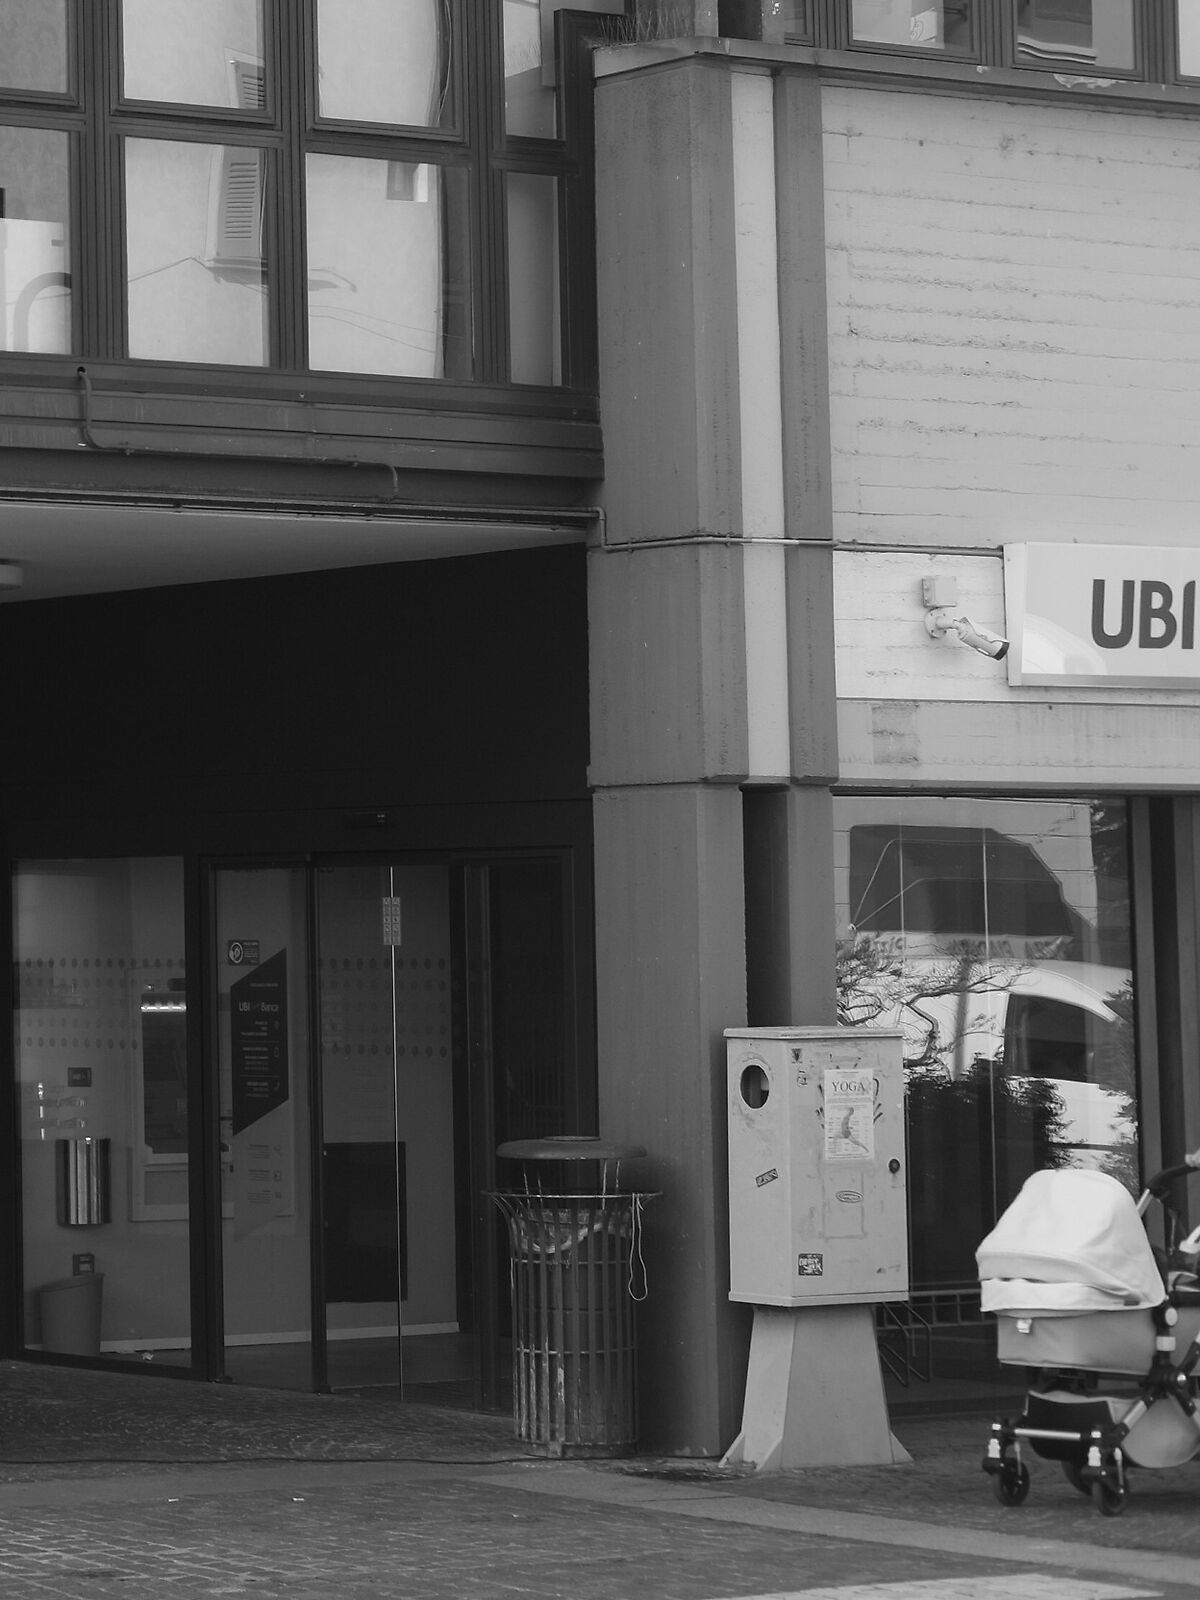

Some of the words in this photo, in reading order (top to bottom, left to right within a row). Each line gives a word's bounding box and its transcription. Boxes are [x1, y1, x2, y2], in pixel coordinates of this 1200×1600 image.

[1091, 578, 1196, 650] UBI
[239, 1001, 251, 1012] UBI
[831, 1081, 866, 1092] YOGA
